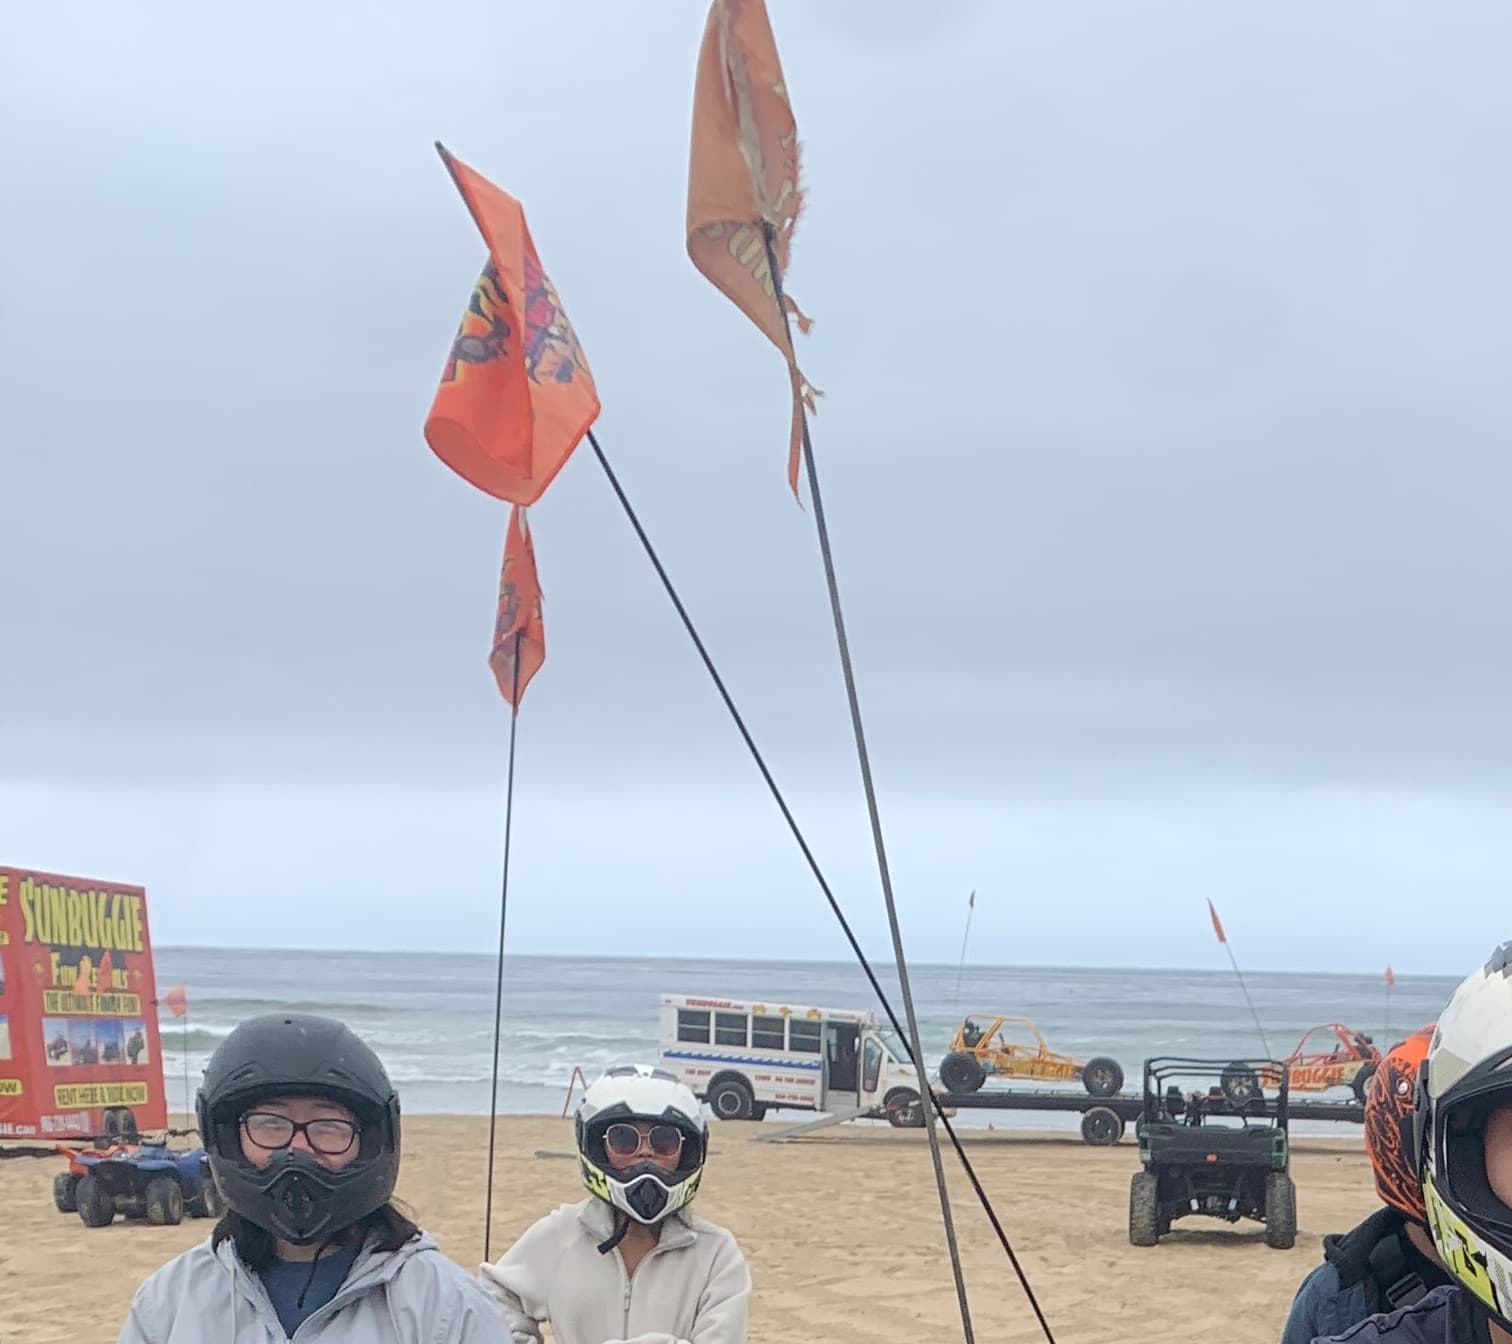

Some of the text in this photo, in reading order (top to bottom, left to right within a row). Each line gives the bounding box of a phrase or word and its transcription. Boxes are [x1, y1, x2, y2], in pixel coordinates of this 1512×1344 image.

[20, 877, 144, 952] SUNBUGGIE
[56, 1087, 77, 1106] RENT
[79, 1086, 99, 1104] HERE
